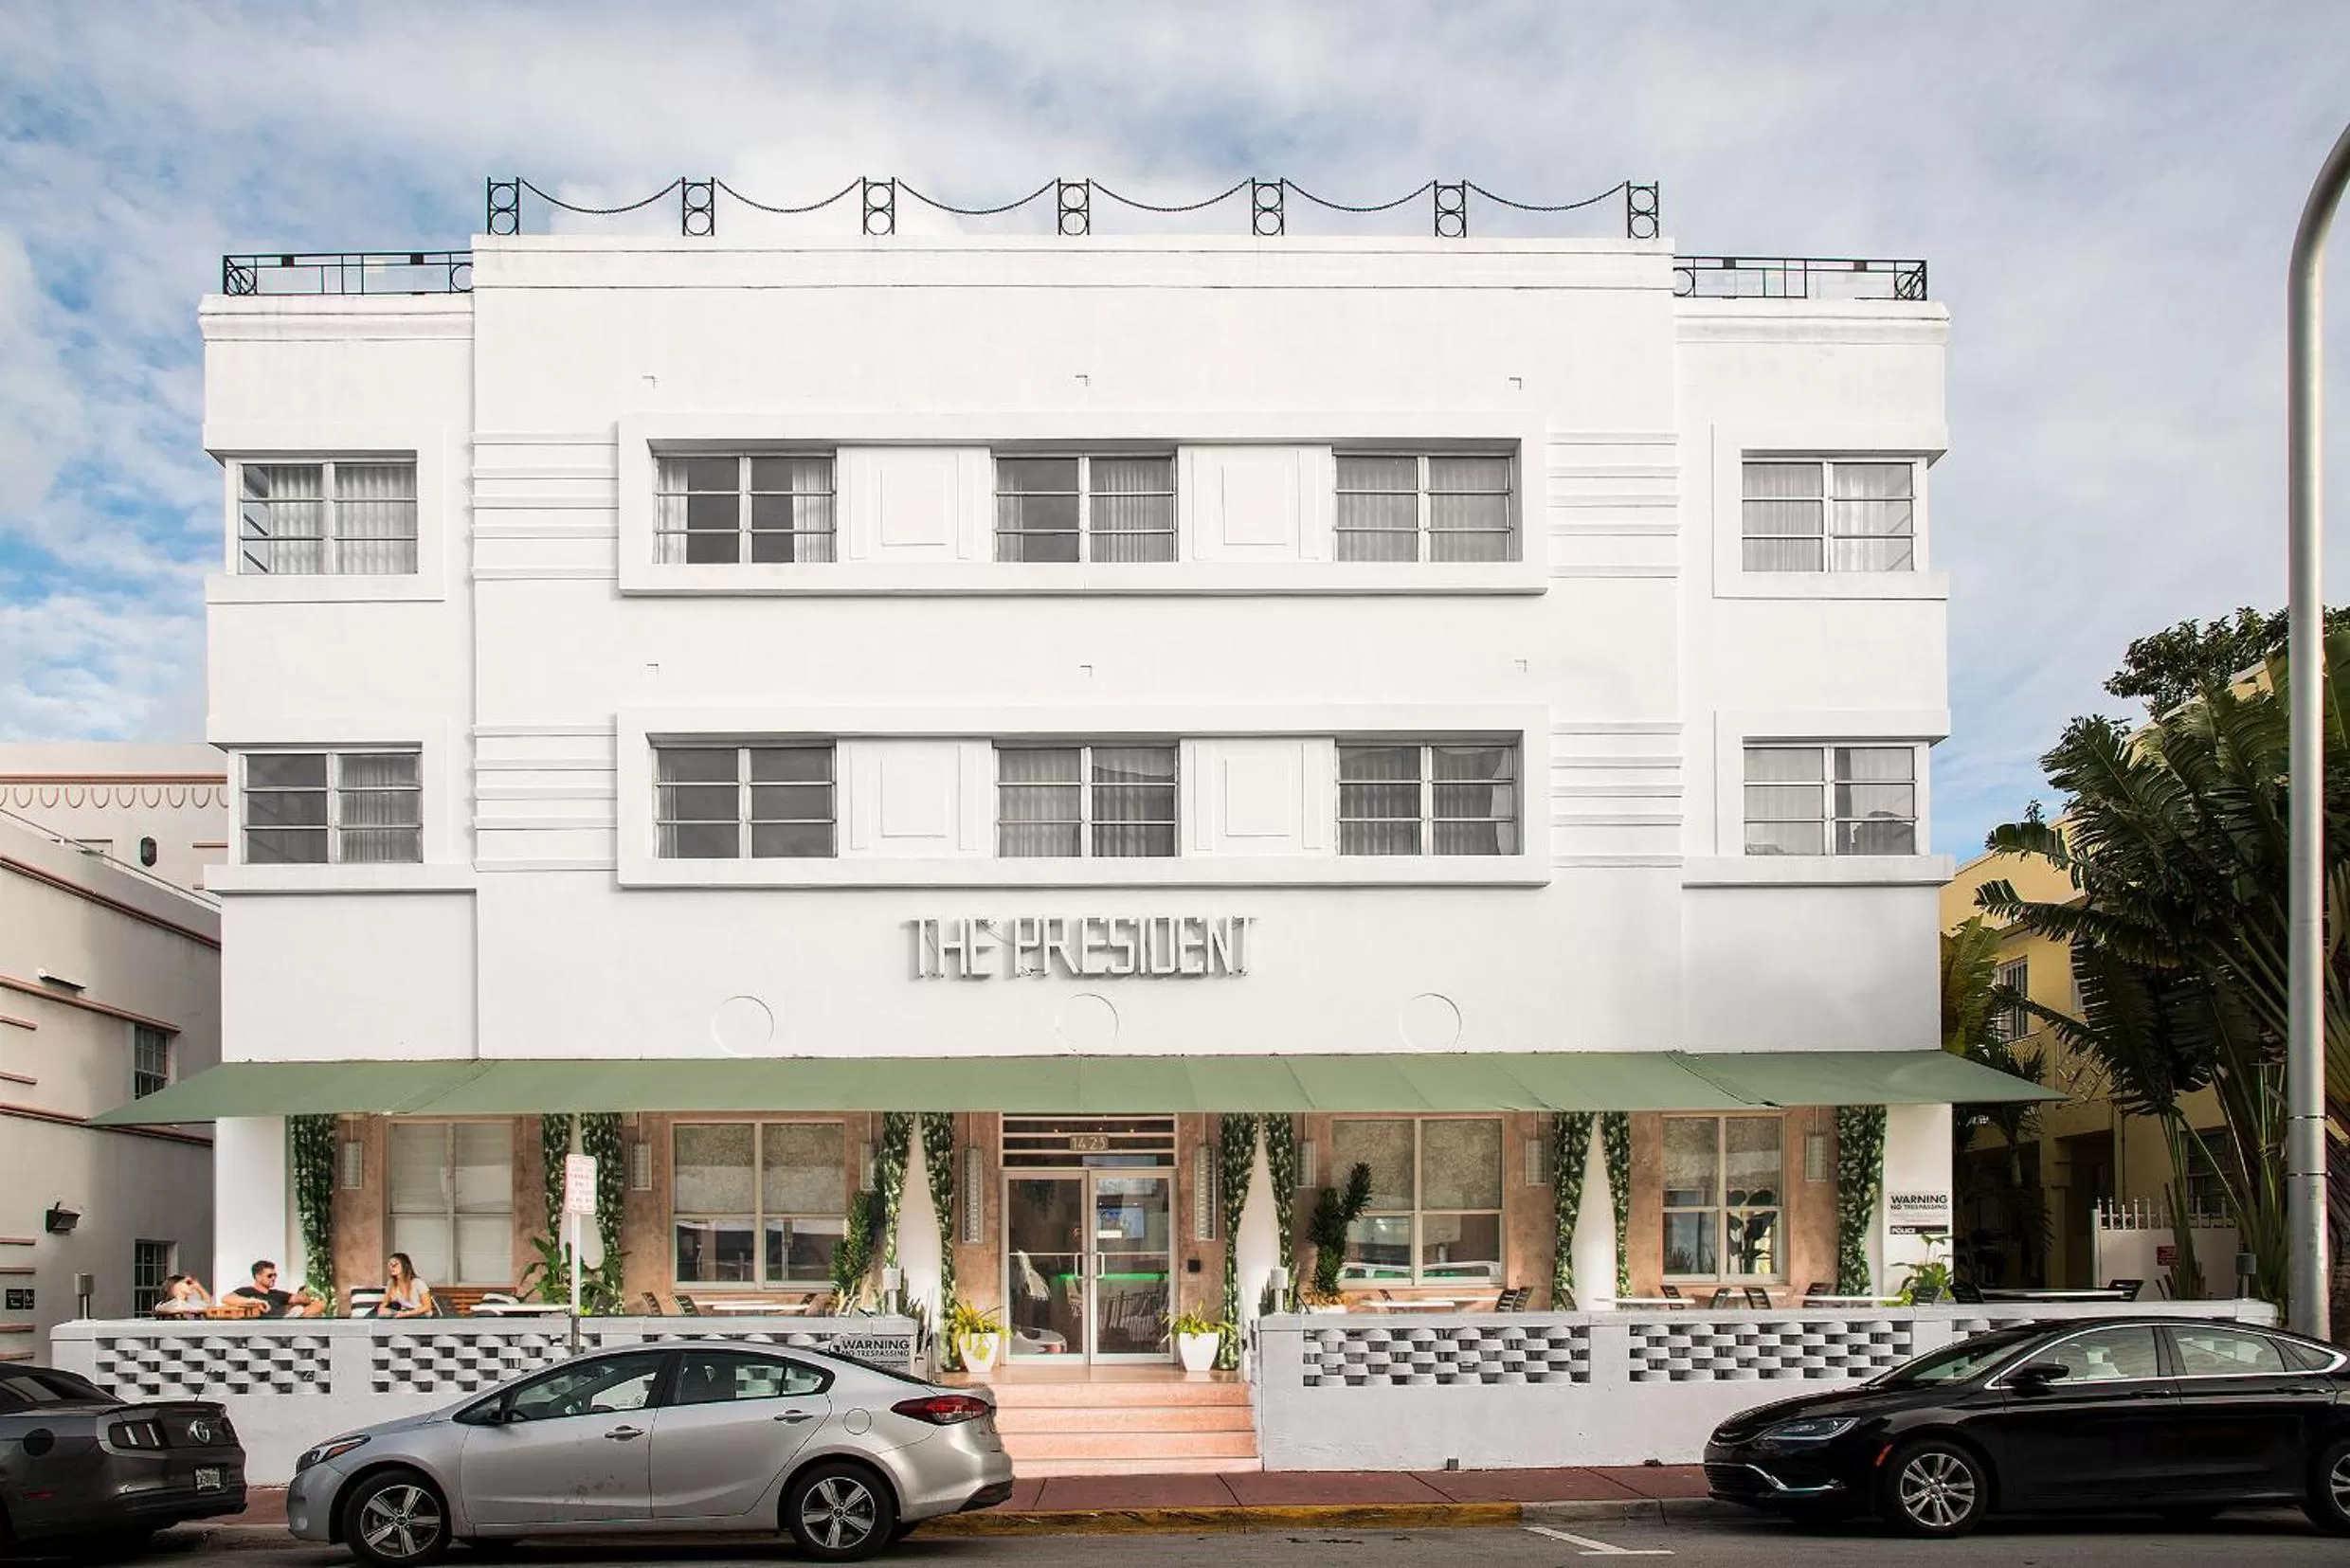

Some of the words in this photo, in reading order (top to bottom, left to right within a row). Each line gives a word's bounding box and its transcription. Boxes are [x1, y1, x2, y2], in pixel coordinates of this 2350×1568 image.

[908, 916, 1002, 978] THE
[1014, 916, 1258, 979] PRESIDENT
[1890, 1195, 1948, 1204] WARNING
[841, 1340, 910, 1350] WARNING
